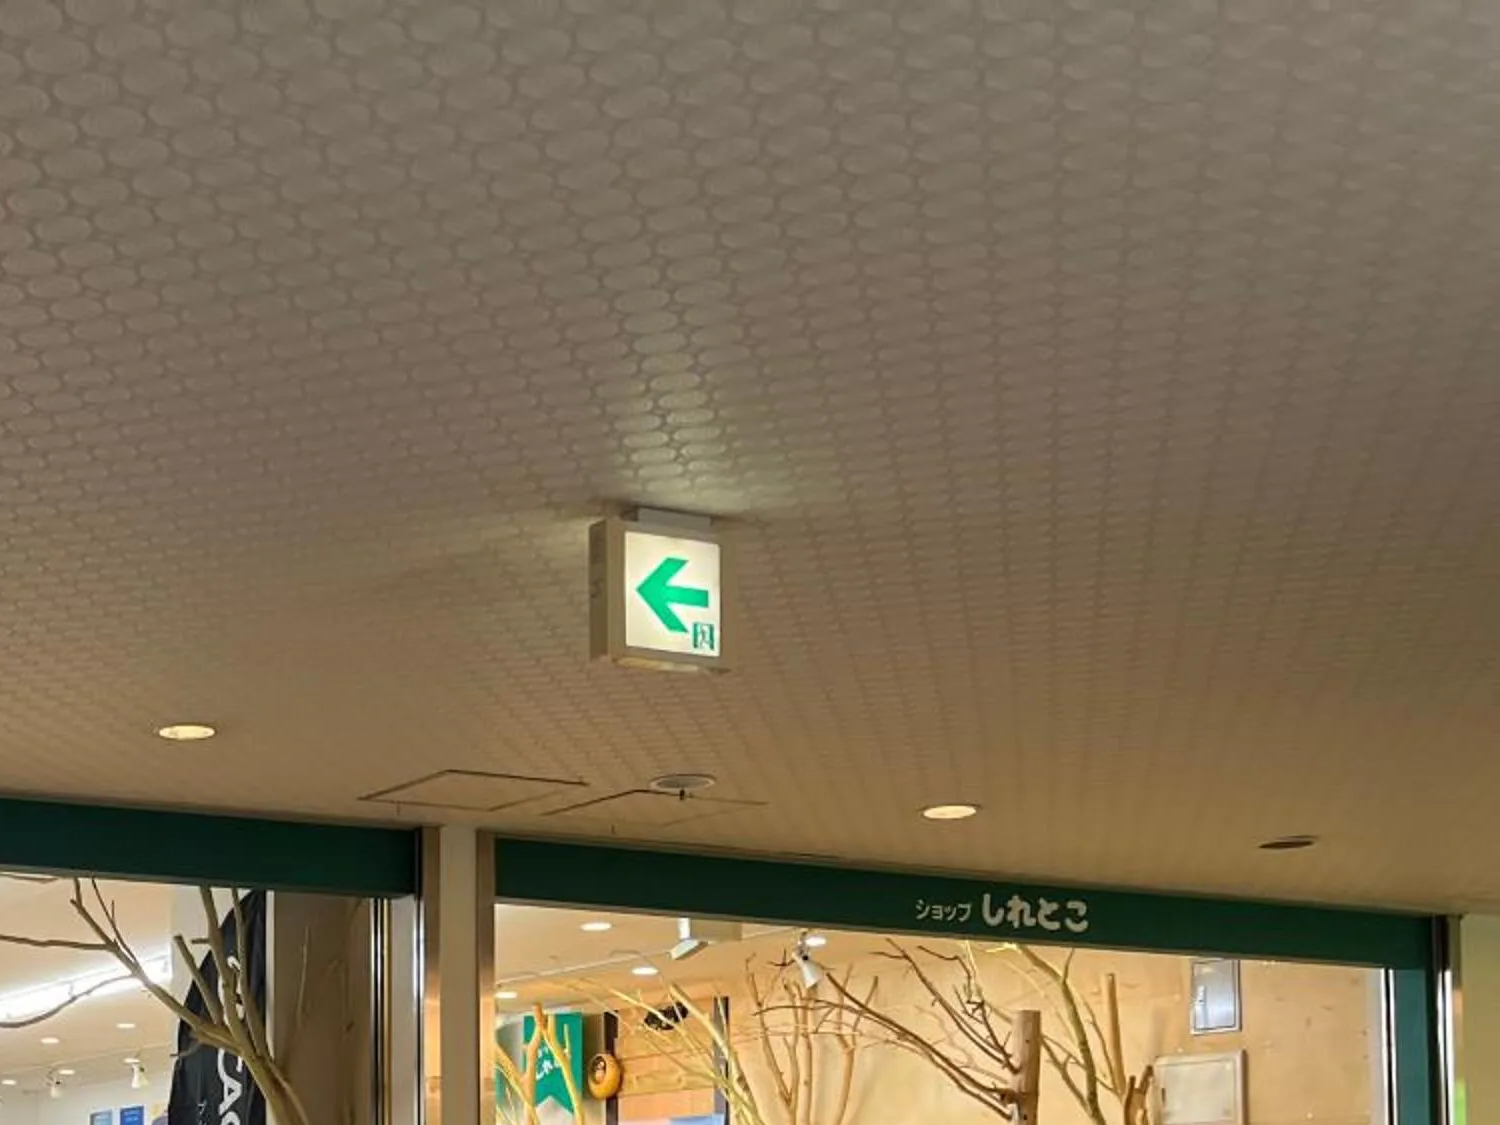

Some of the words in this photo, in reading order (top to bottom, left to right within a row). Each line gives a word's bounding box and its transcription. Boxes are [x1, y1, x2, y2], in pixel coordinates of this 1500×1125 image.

[915, 899, 972, 922] ショップ
[982, 893, 1089, 932] しれとこ
